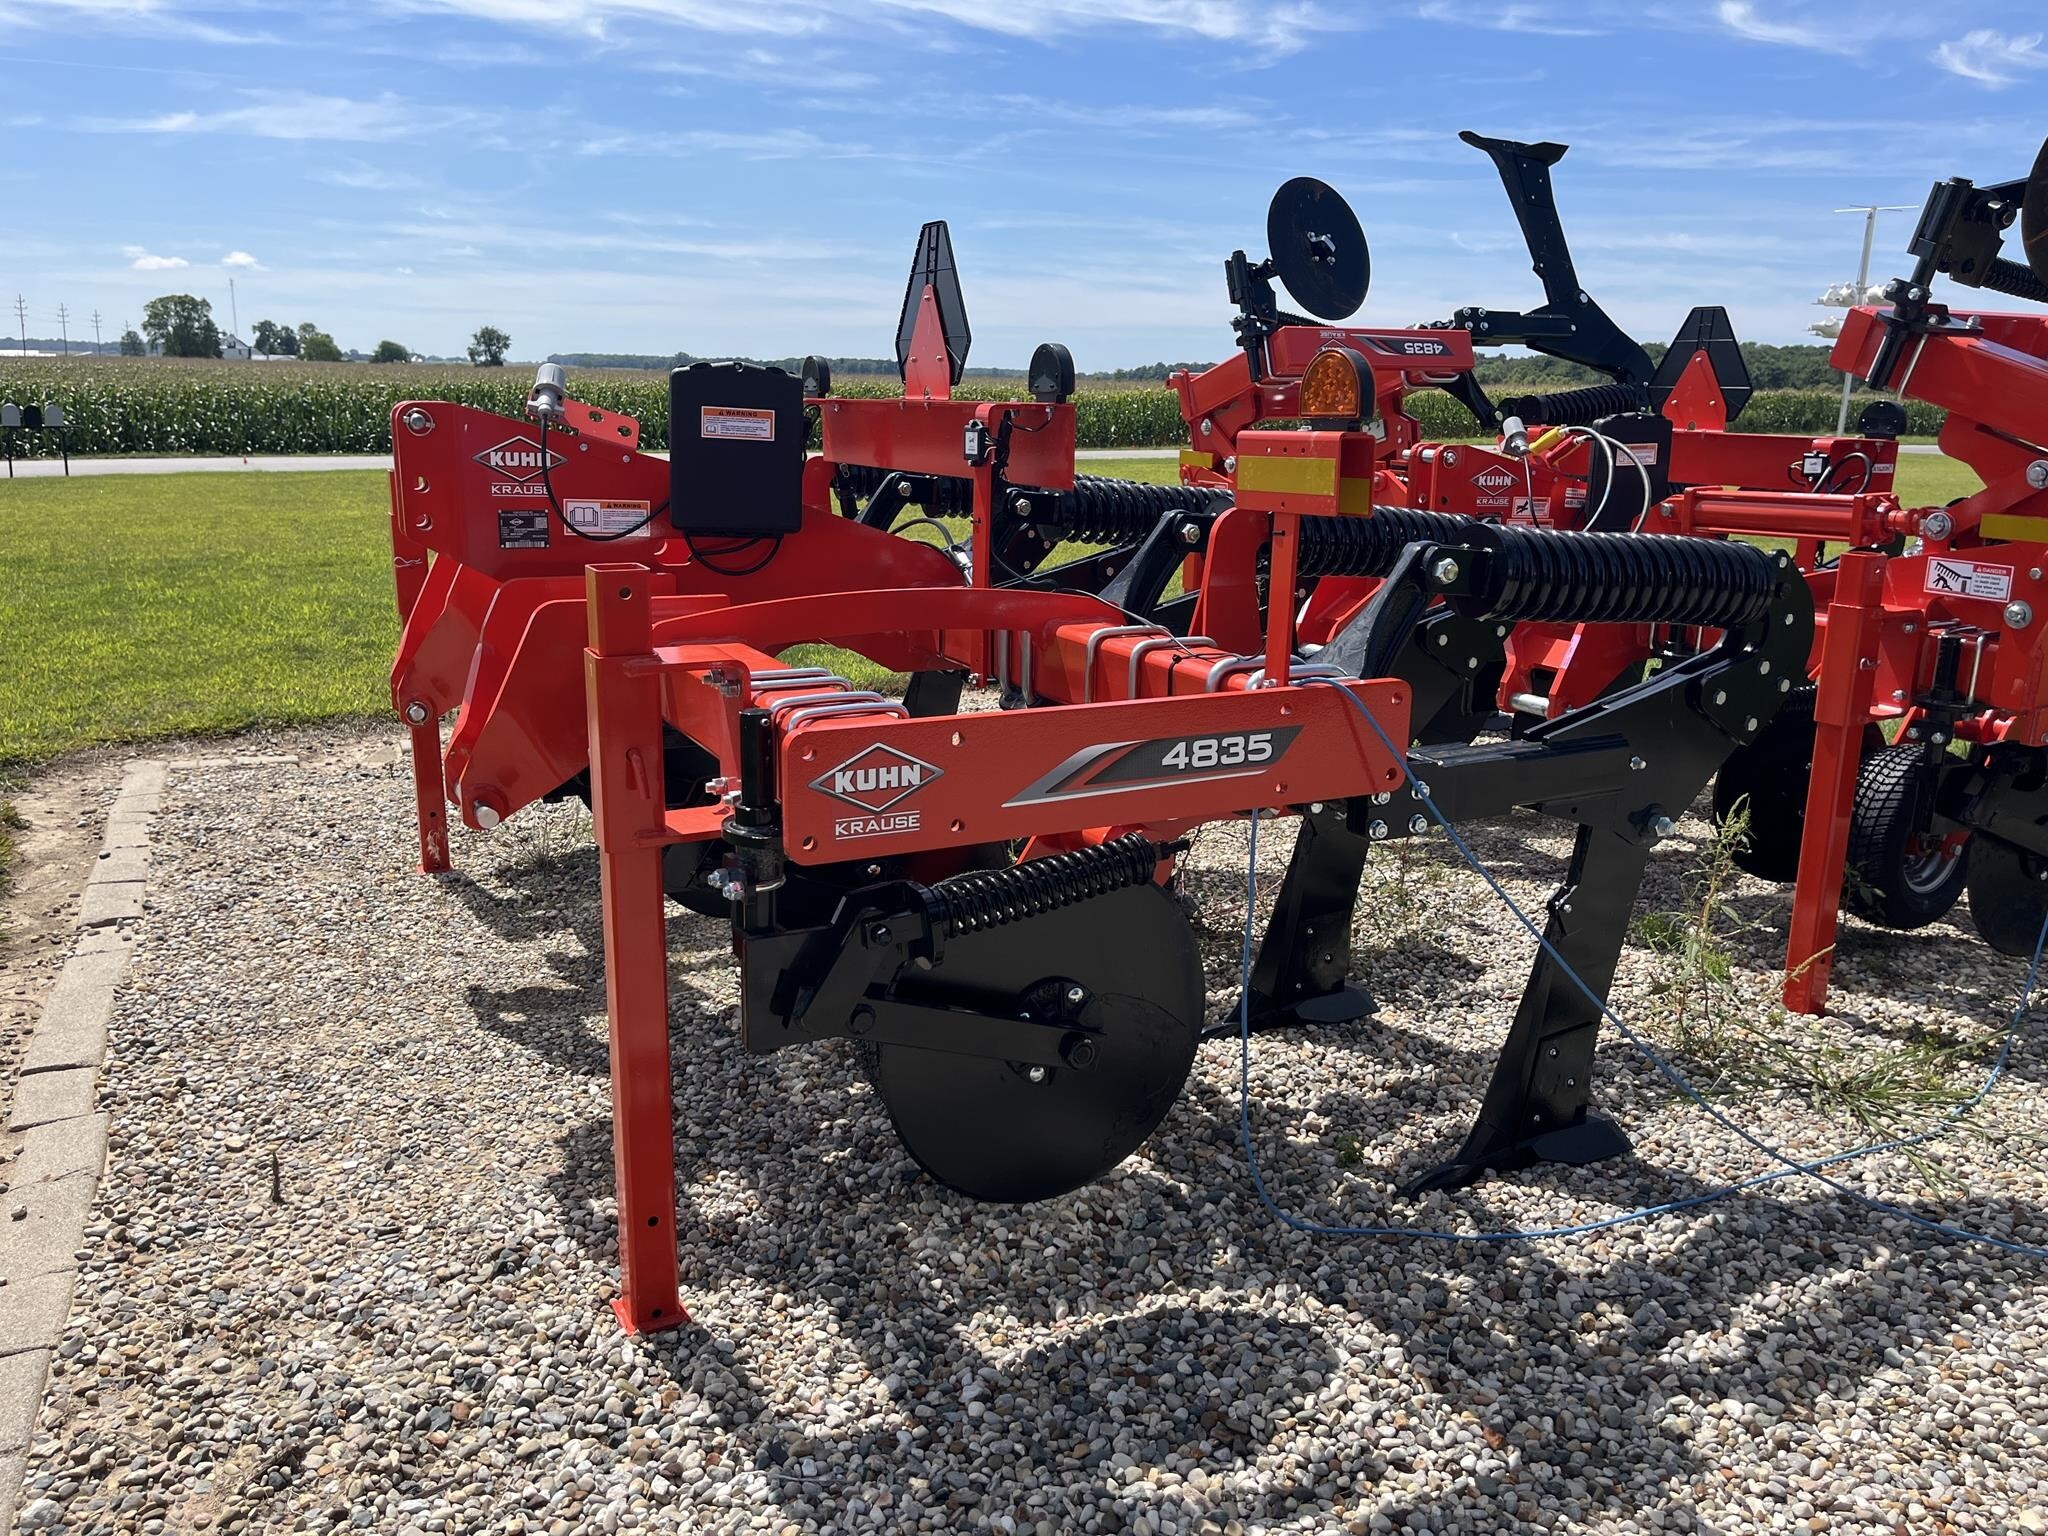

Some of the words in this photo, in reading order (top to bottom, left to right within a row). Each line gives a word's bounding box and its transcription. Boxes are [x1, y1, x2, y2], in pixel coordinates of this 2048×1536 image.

[1404, 342, 1443, 354] 4835
[1478, 475, 1512, 486] KUHN
[1162, 733, 1272, 770] 4835
[834, 764, 921, 794] KUHN
[835, 815, 920, 836] KRAUSE
